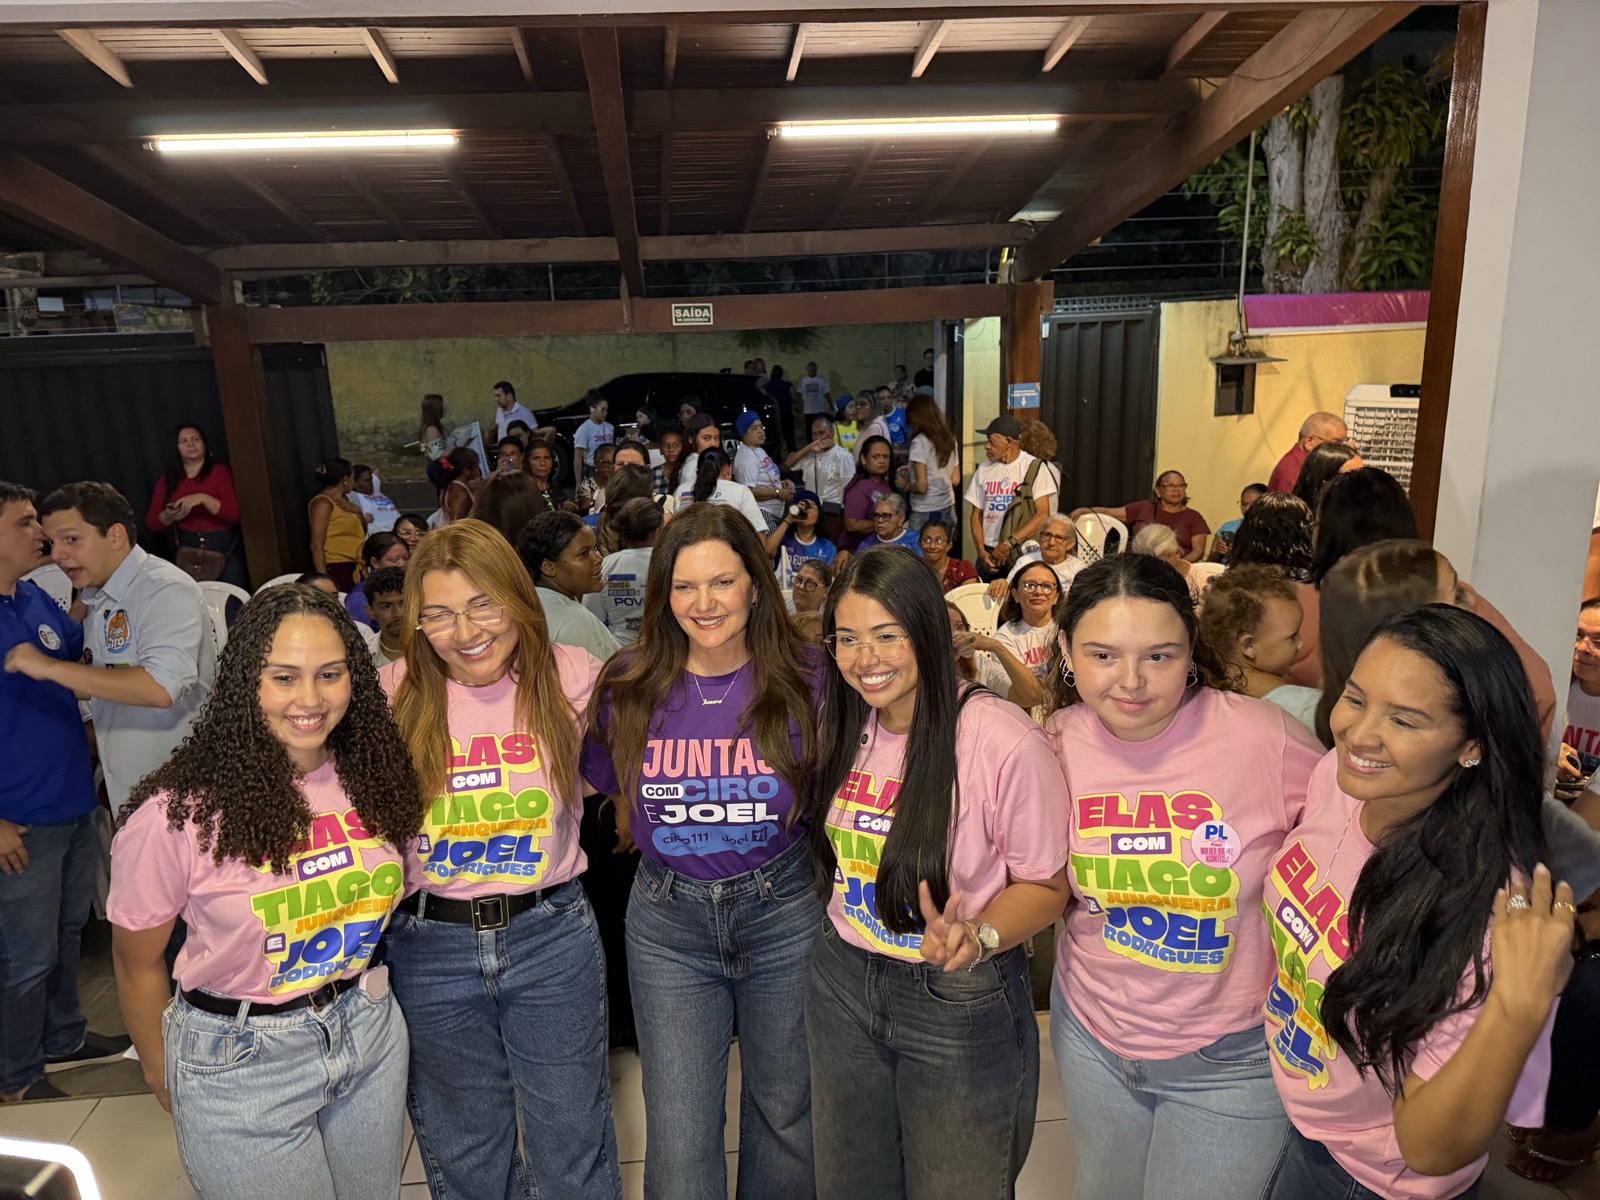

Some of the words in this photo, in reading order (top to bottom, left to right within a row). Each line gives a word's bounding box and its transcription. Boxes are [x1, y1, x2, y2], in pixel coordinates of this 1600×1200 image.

[675, 307, 710, 318] SAÍDA
[614, 598, 643, 606] POV
[445, 734, 536, 768] LAS
[452, 772, 496, 788] COM
[646, 786, 679, 797] COM
[680, 776, 779, 802] CIRO
[432, 789, 549, 826] IAGO
[644, 804, 660, 823] E
[660, 803, 778, 824] JOEL
[1078, 794, 1214, 830] ELAS
[439, 818, 547, 838] JUNQUEIRA
[1205, 825, 1228, 840] PL
[420, 836, 428, 850] E
[428, 834, 543, 866] JOEL
[1118, 836, 1166, 850] COM
[302, 850, 348, 875] COM
[423, 862, 536, 878] RODRIGUES
[1071, 854, 1232, 897] TIAGO
[252, 864, 402, 928] TIAGO
[1106, 892, 1231, 912] JUNQUEIRA
[843, 904, 922, 950] RODRIGUE
[1105, 906, 1230, 950] JOEL
[1282, 906, 1314, 948] COM
[266, 936, 282, 950] E
[1104, 924, 1224, 964] RODRIGUES
